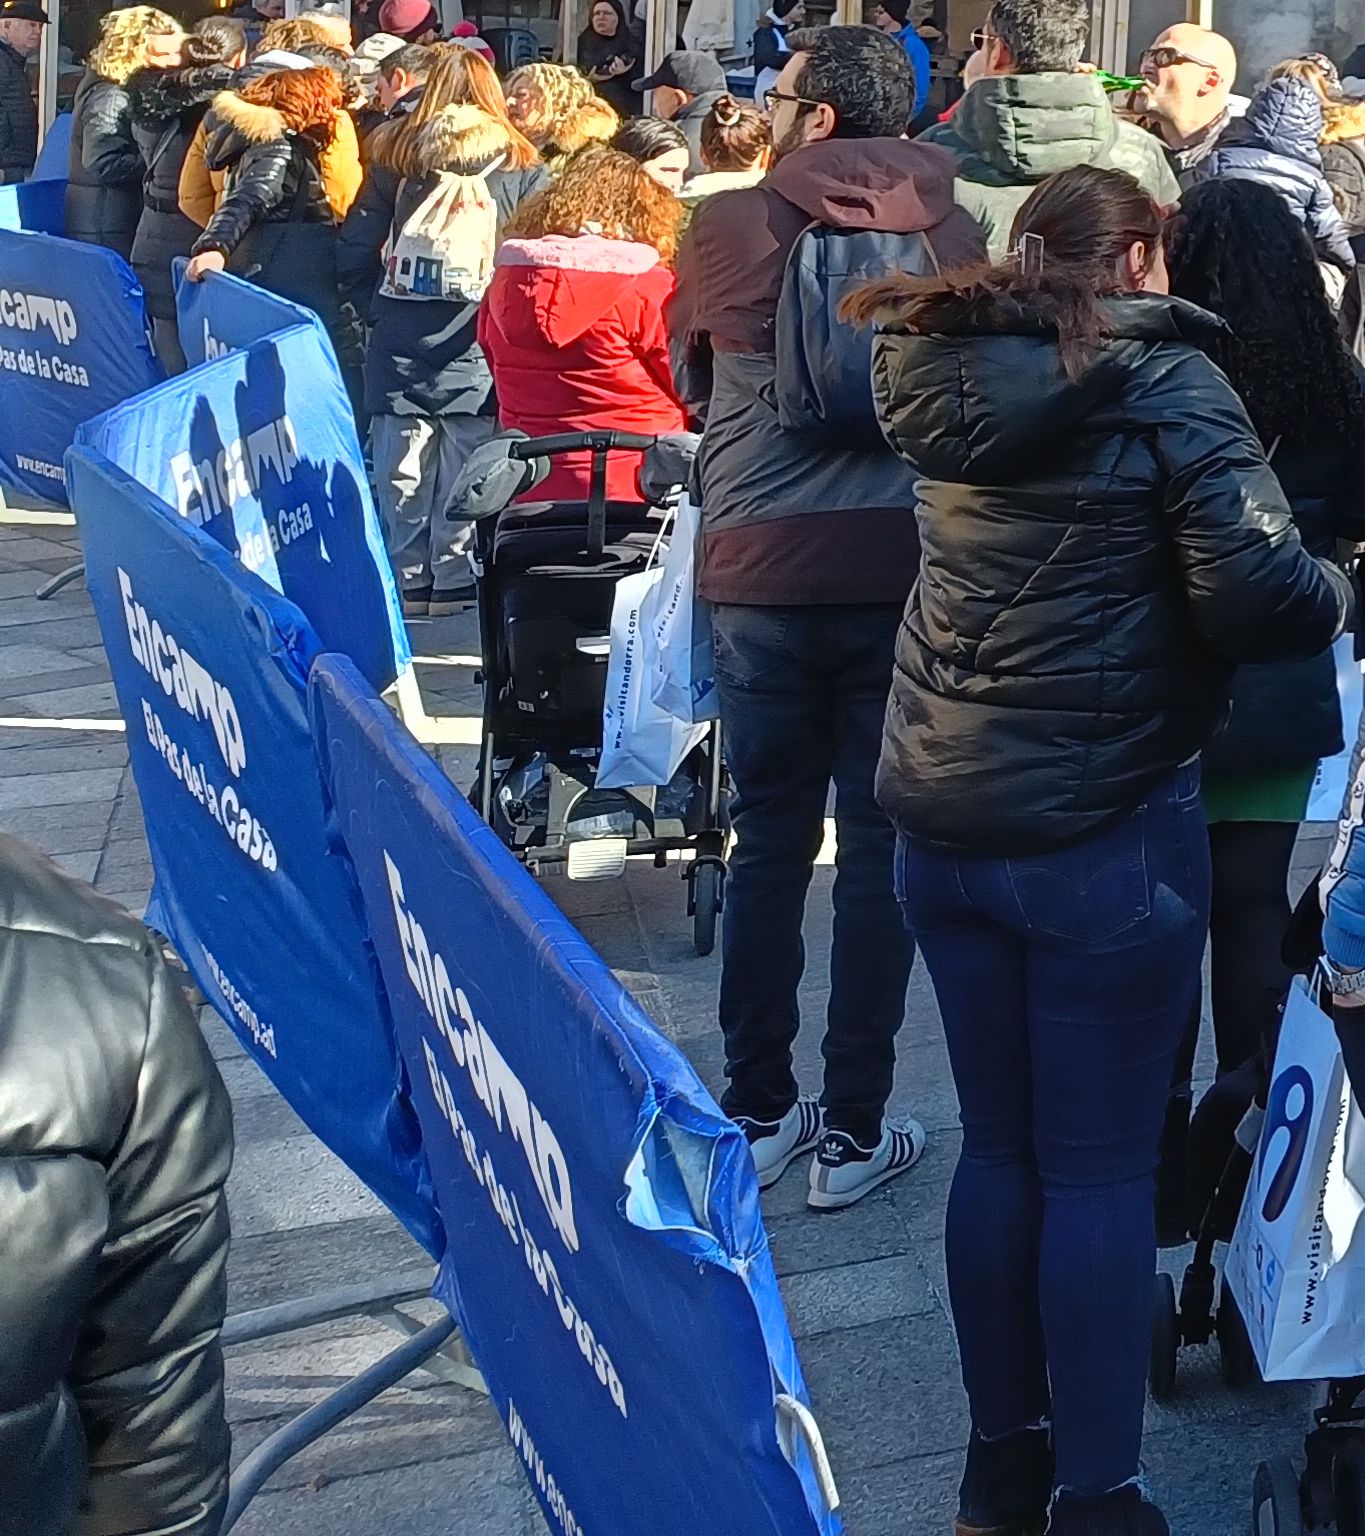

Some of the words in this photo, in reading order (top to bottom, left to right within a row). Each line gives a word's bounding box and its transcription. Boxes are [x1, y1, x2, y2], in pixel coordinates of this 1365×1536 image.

[0, 288, 78, 345] camp
[17, 348, 37, 376] de
[35, 350, 52, 379] la
[51, 356, 90, 388] Casa
[169, 414, 299, 528] Encamp
[243, 530, 266, 570] de
[278, 502, 314, 545] Casa
[117, 566, 247, 778] Encamp
[140, 697, 159, 751] El
[153, 713, 183, 780] Pas
[181, 747, 205, 805] de
[199, 762, 223, 826] la
[220, 785, 278, 872] Casa
[382, 848, 580, 1255] Encamp
[421, 1035, 449, 1122] El
[439, 1069, 484, 1188] Pas
[483, 1148, 519, 1246] de
[510, 1190, 549, 1298] la
[541, 1247, 629, 1420] Casa
